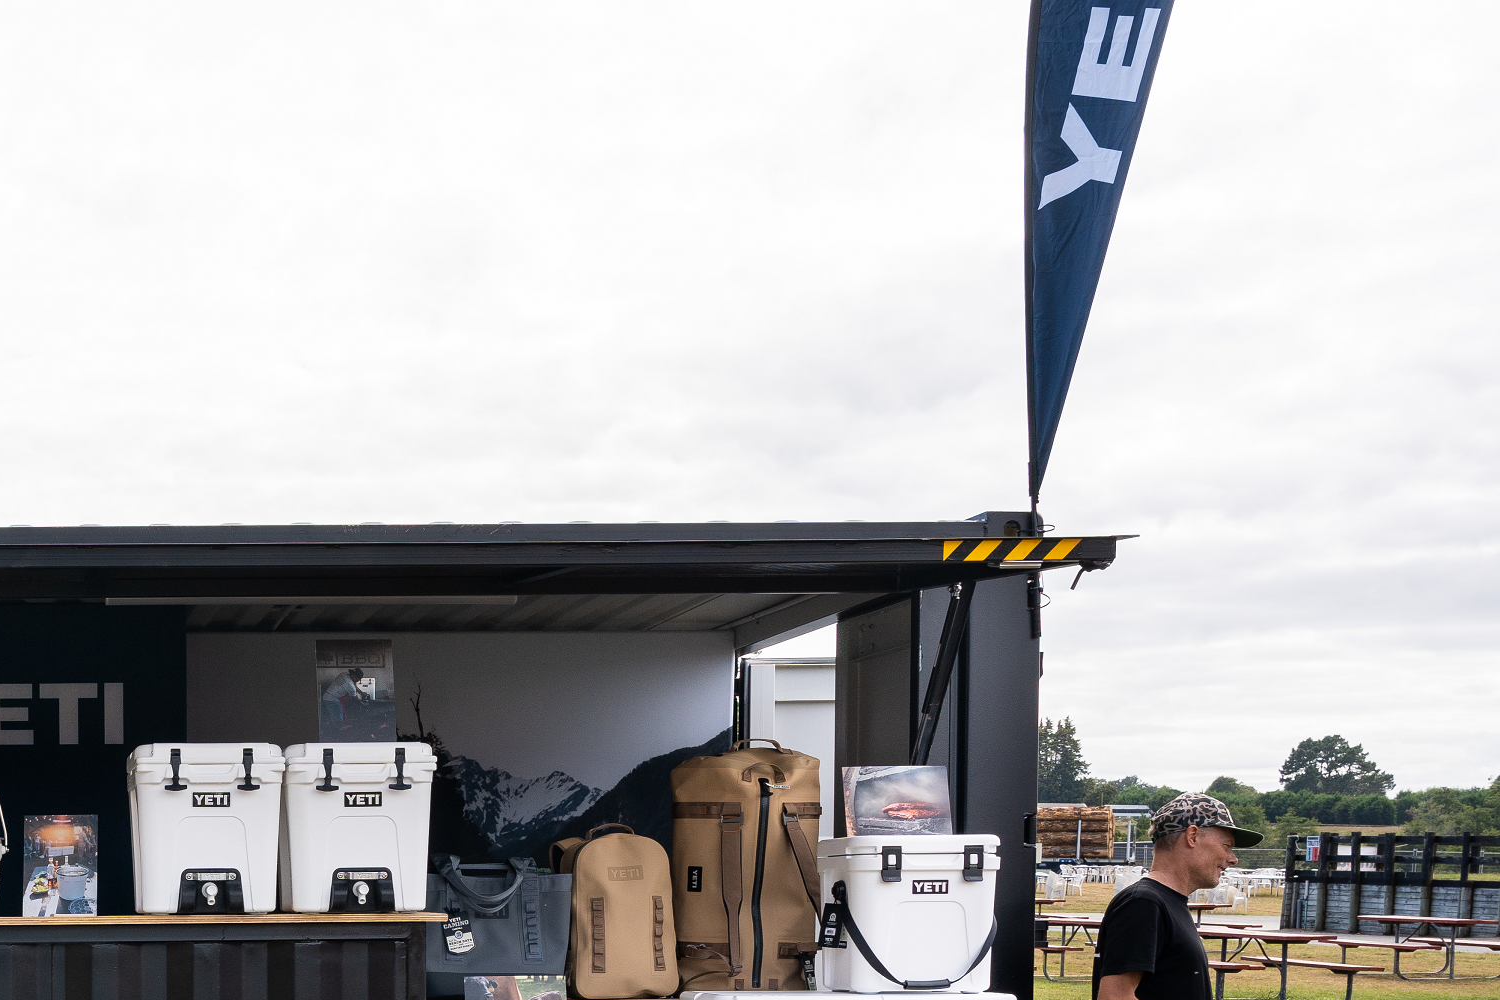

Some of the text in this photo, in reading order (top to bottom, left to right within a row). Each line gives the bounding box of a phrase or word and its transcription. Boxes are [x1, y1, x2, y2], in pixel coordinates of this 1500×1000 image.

[194, 794, 228, 806] YETI
[345, 794, 380, 805] YETI
[611, 868, 640, 878] YETI
[913, 882, 947, 892] YETI
[443, 920, 469, 930] CAMINO
